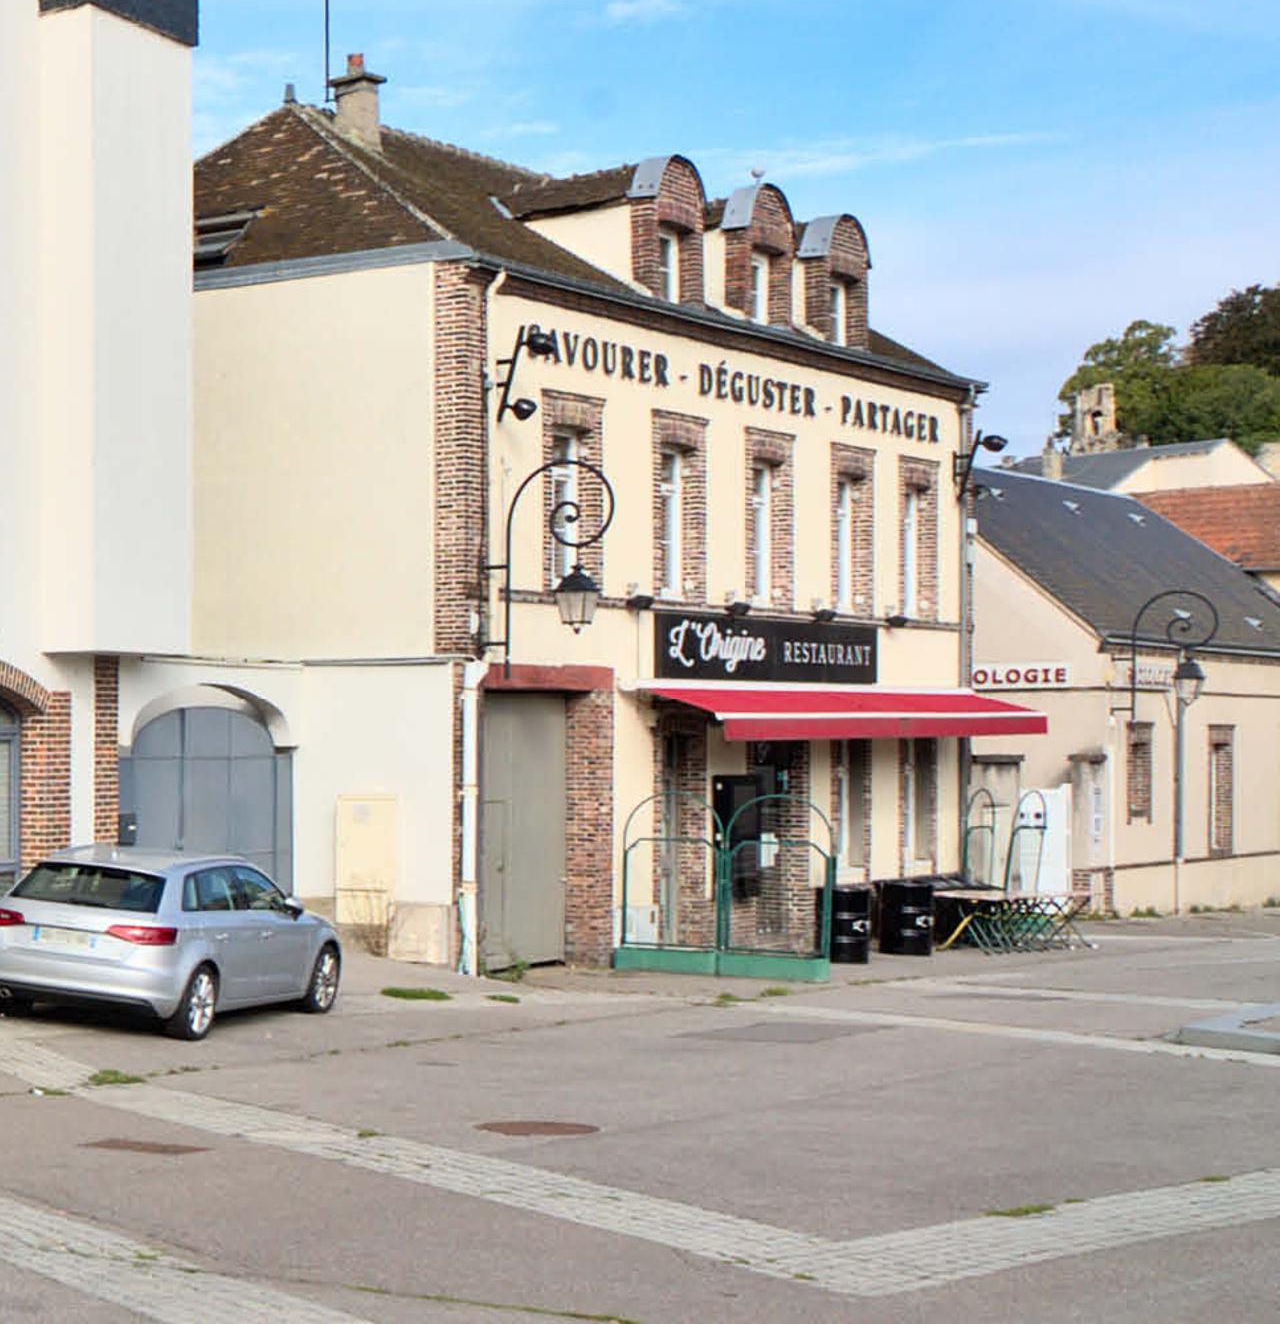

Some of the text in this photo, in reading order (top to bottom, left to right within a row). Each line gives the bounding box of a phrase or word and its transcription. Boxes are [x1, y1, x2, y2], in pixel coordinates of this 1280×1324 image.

[699, 360, 816, 417] DÉGUSTER
[841, 395, 940, 444] PARTAGER
[783, 641, 872, 666] RESTAURANT
